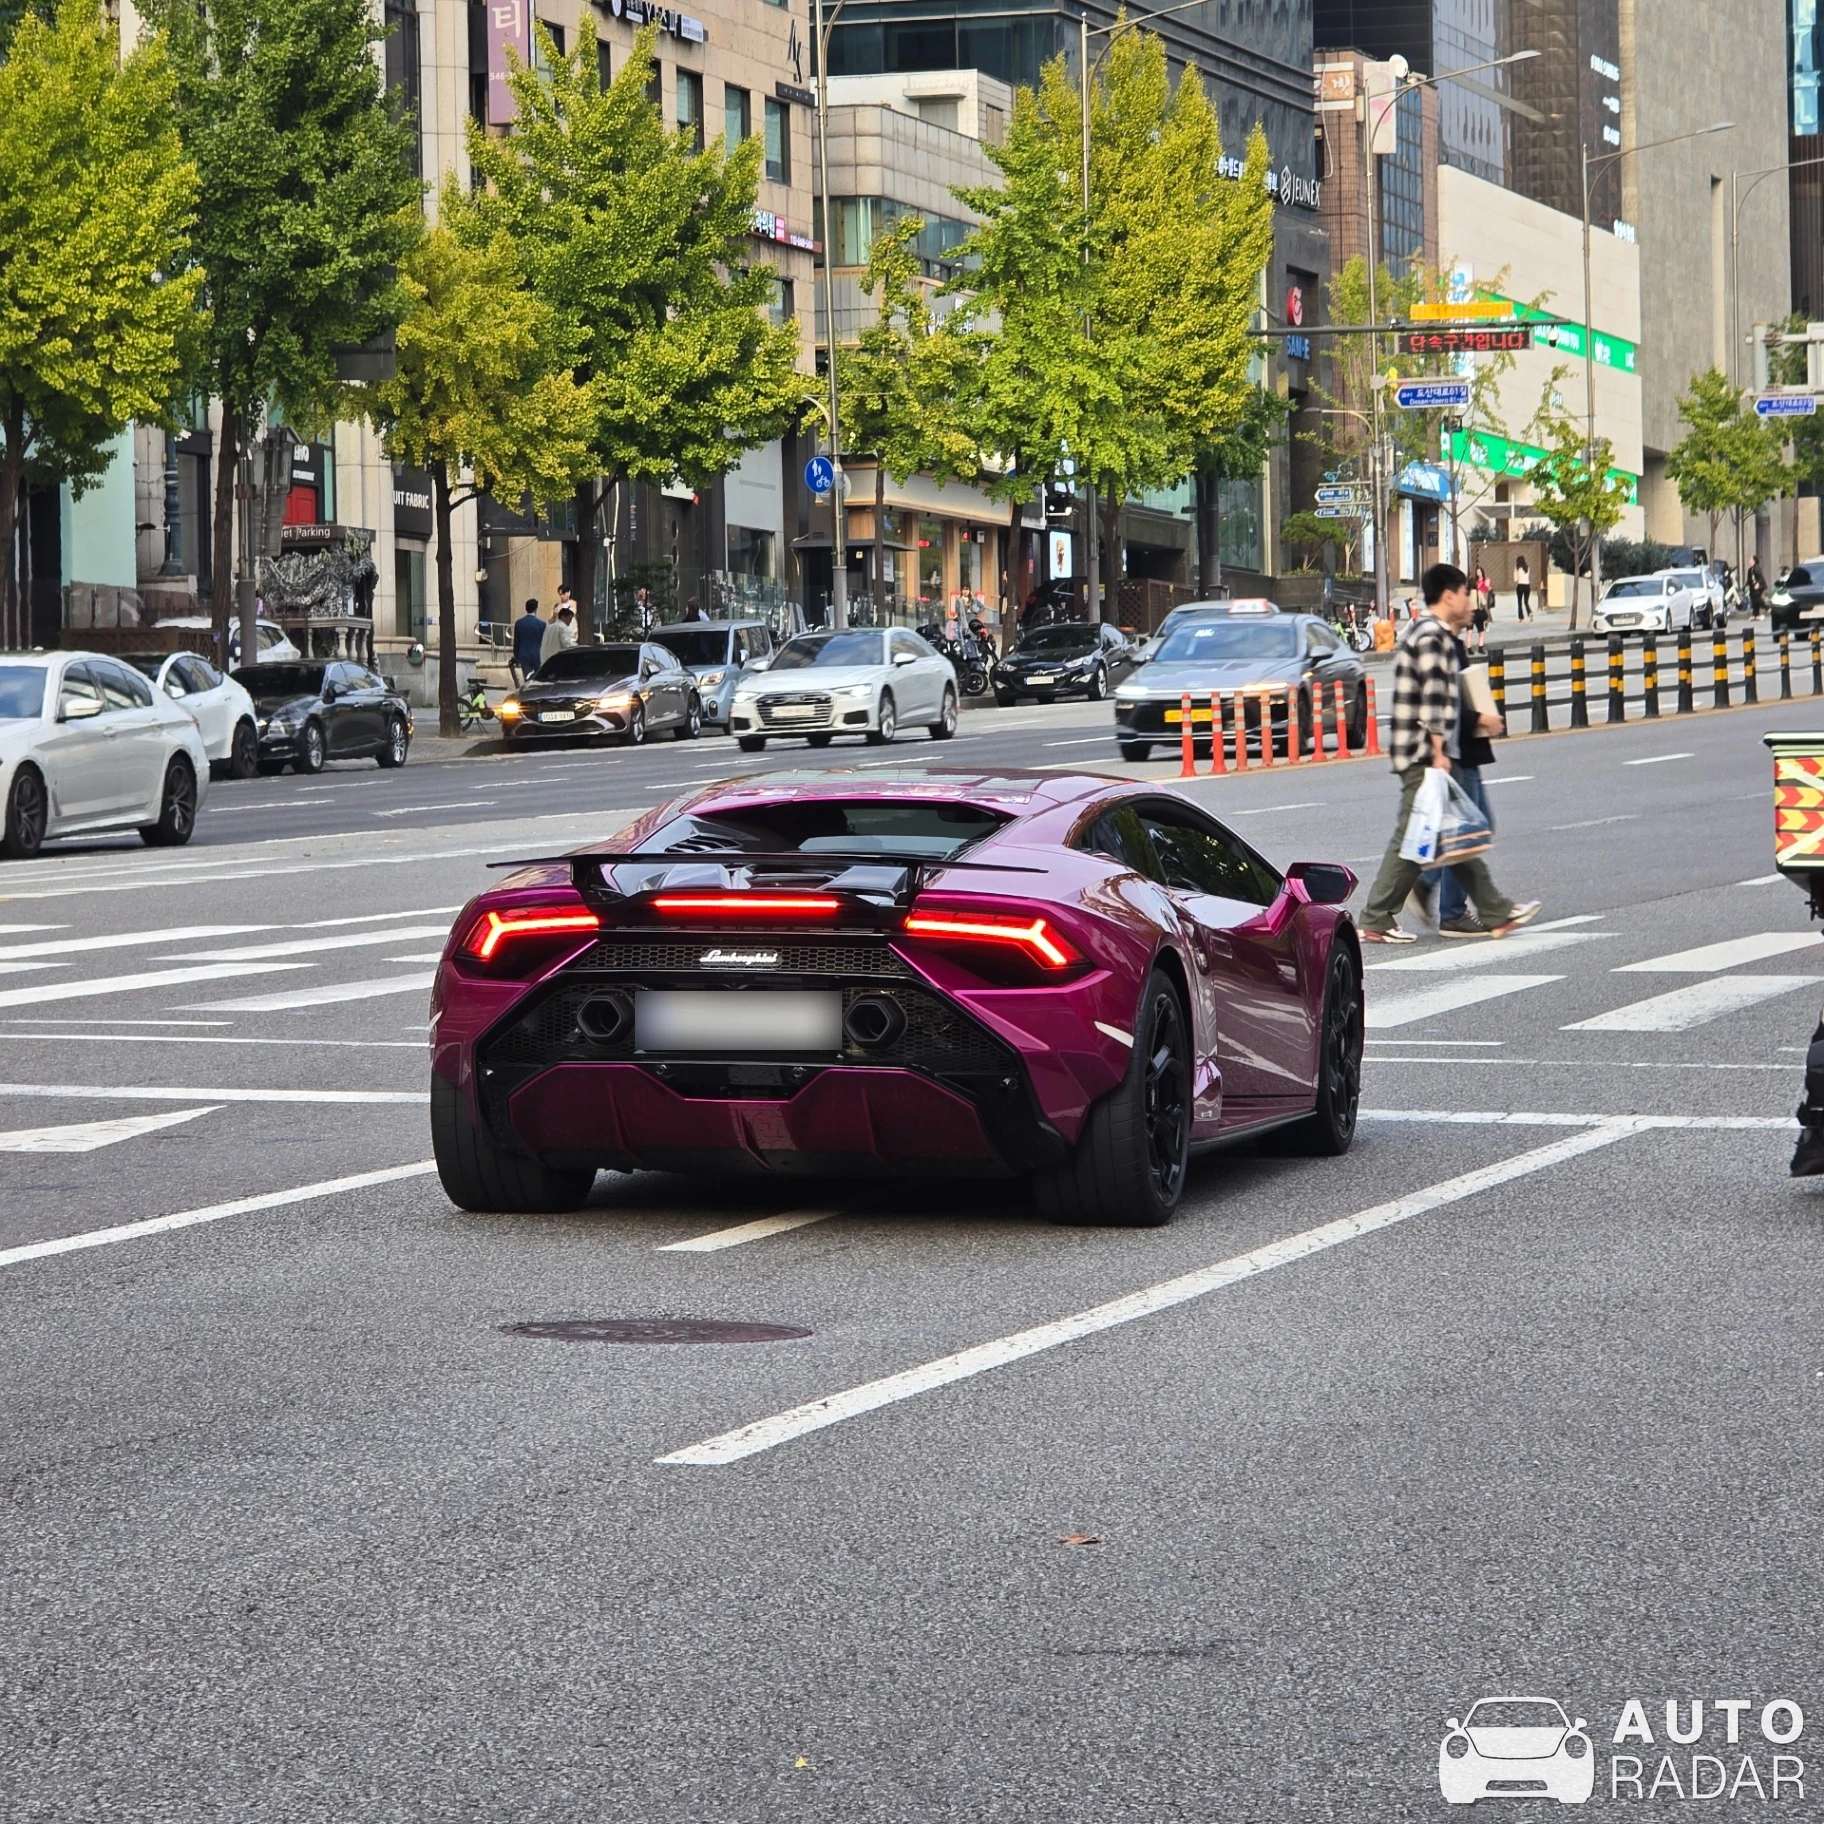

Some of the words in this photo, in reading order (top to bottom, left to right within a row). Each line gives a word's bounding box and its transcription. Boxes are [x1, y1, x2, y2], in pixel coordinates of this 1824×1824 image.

[1291, 173, 1321, 207] JEUNEX
[1410, 332, 1524, 353] 단속구간입니다
[1416, 385, 1467, 398] 도산대로61길
[405, 491, 430, 509] FABRIC
[296, 526, 331, 539] Parking
[700, 949, 779, 966] Lamborghini
